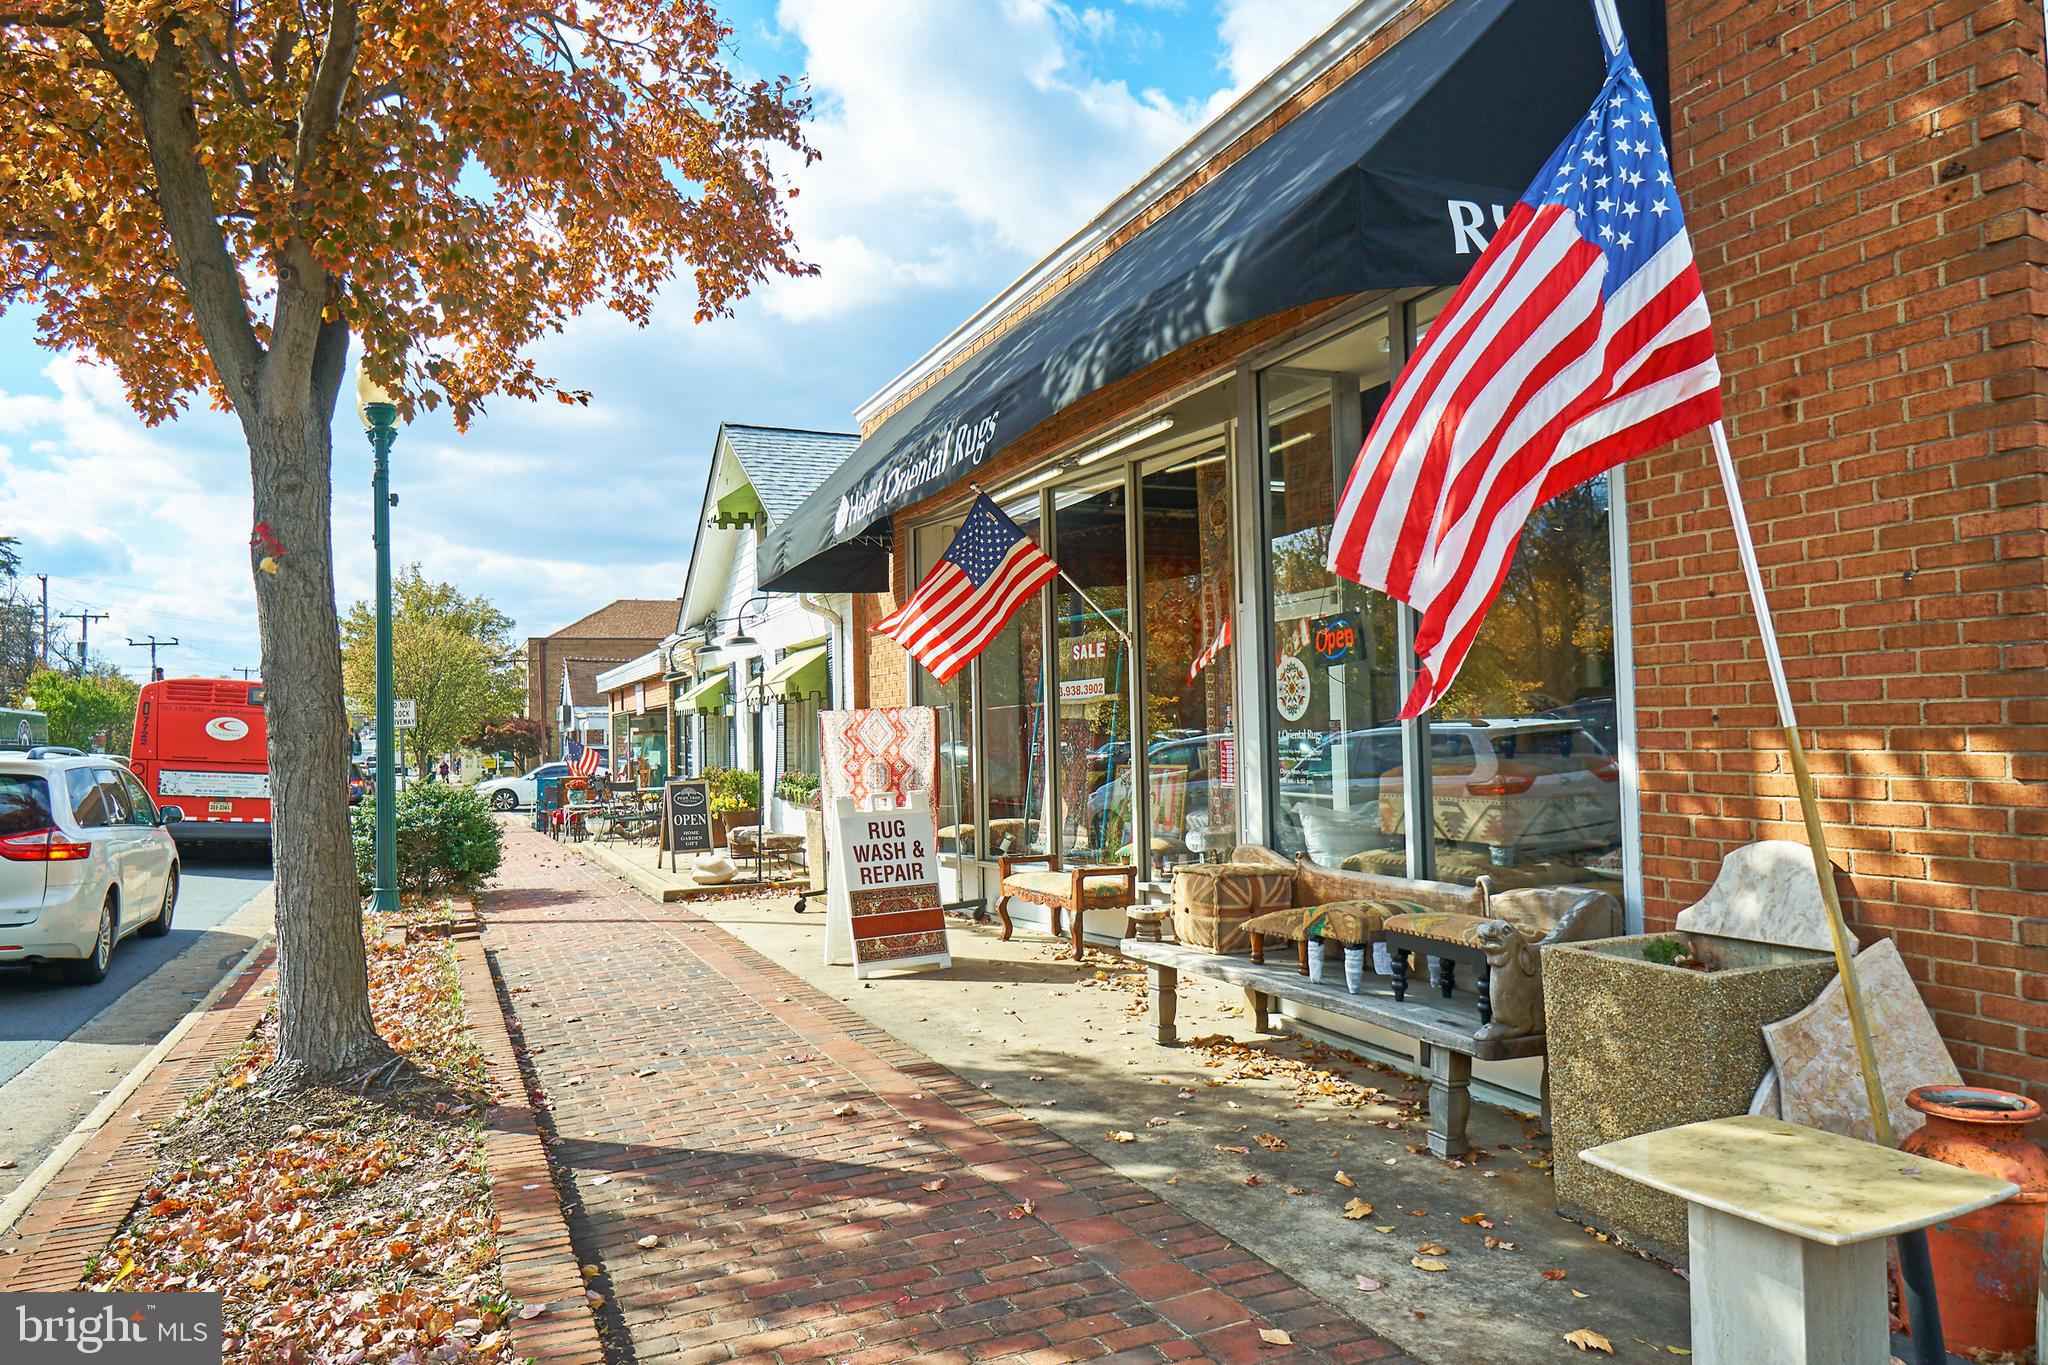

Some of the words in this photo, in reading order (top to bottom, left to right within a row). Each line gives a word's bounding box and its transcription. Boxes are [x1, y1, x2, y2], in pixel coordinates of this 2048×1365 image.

[848, 477, 884, 528] Herat
[883, 430, 952, 504] Oriental
[951, 410, 1000, 466] Rugs
[1073, 642, 1106, 660] SALE
[1315, 627, 1354, 655] Open
[1281, 728, 1307, 740] Oriental
[1307, 729, 1323, 745] Rugs
[674, 814, 707, 826] OPEN
[868, 820, 906, 840] RUG
[853, 841, 907, 863] WASH
[912, 840, 925, 858] &
[860, 862, 925, 885] REPAIR
